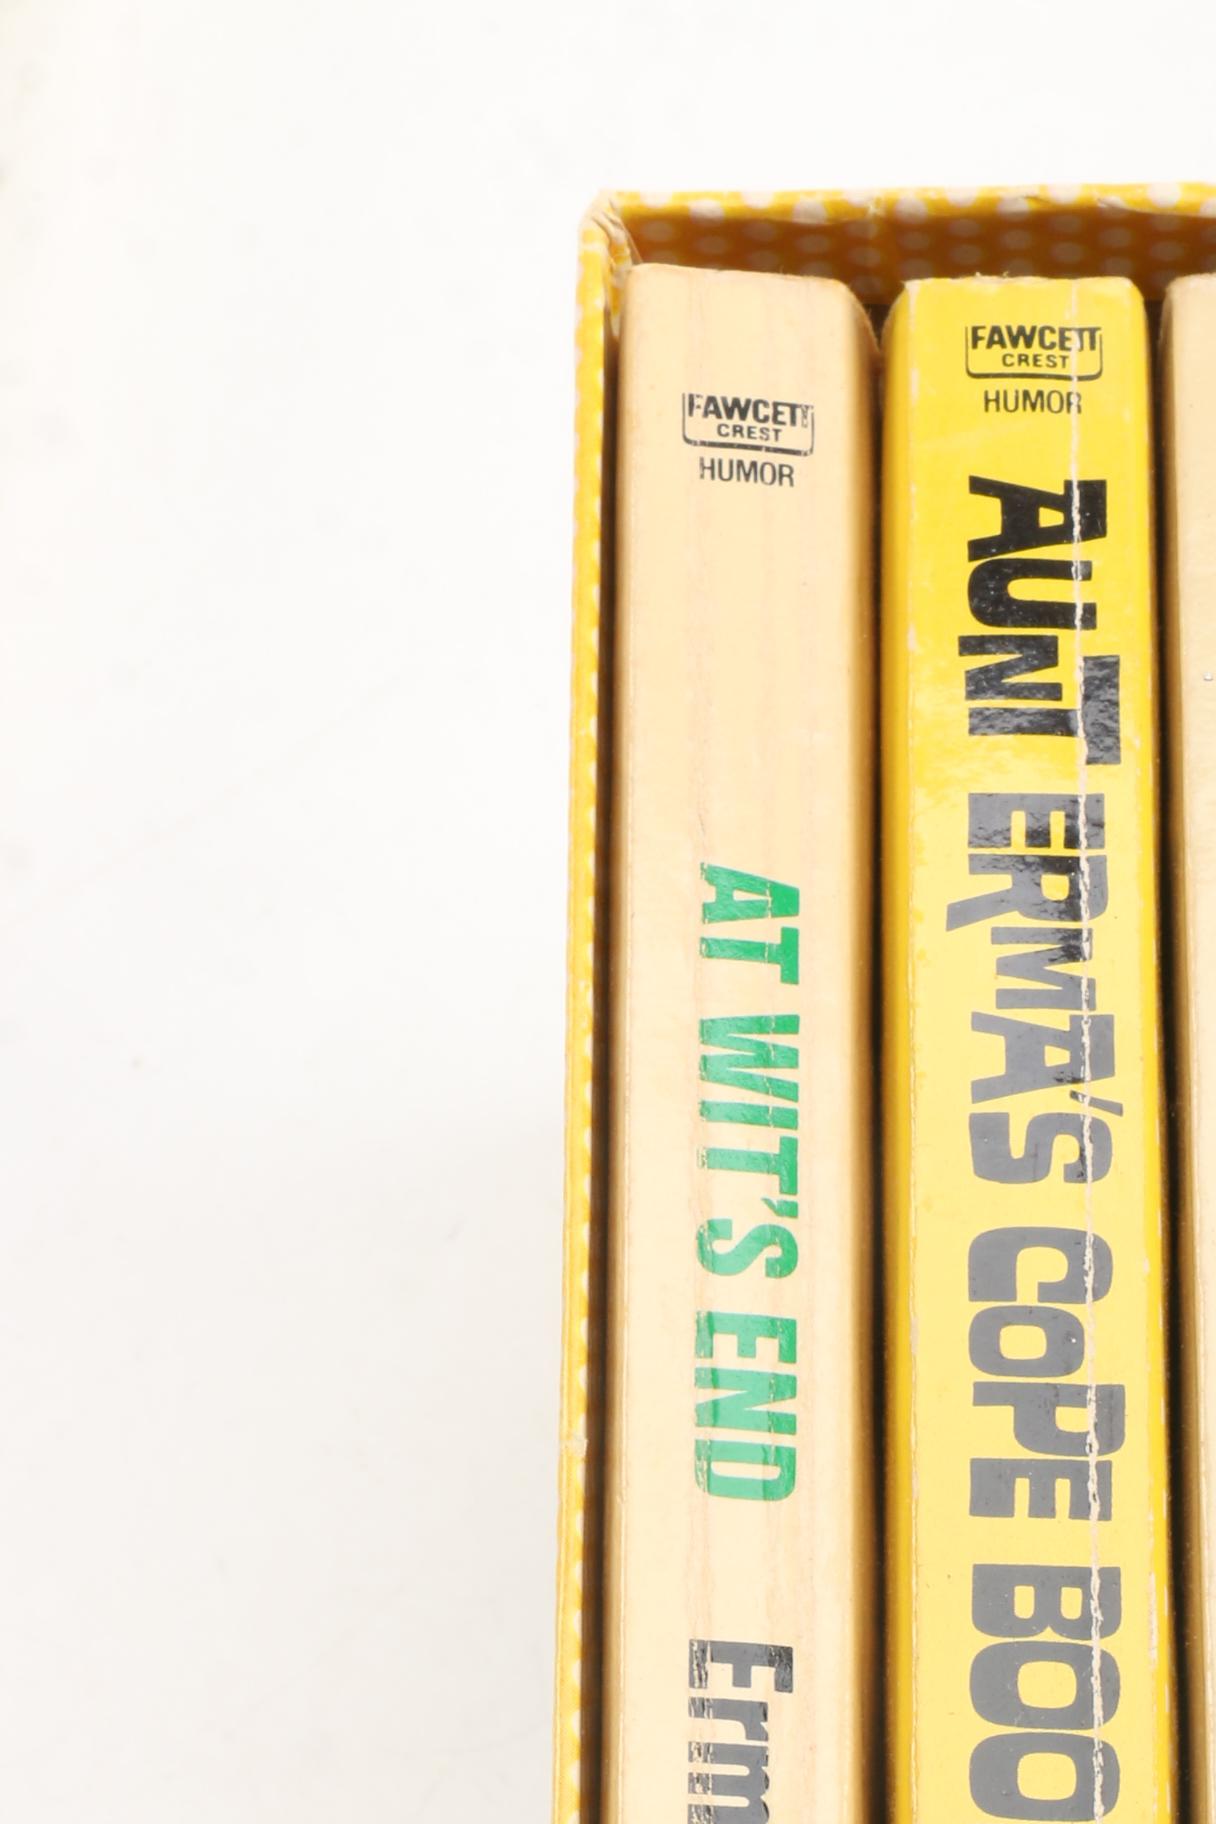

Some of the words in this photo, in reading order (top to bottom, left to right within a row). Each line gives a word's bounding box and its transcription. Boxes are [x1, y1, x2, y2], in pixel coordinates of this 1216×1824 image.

[971, 325, 1101, 352] FAWCETT
[1002, 353, 1069, 368] CREST
[688, 393, 814, 428] FAWCETT
[717, 423, 782, 442] CREST
[984, 390, 1082, 414] HUMOR
[700, 456, 795, 487] HUMOR
[958, 475, 1121, 764] AUNT
[699, 861, 799, 985] AT
[946, 792, 1124, 1184] ERMA'S
[696, 1014, 799, 1279] WIT'S
[694, 1310, 798, 1502] END
[968, 1226, 1126, 1521] COPE
